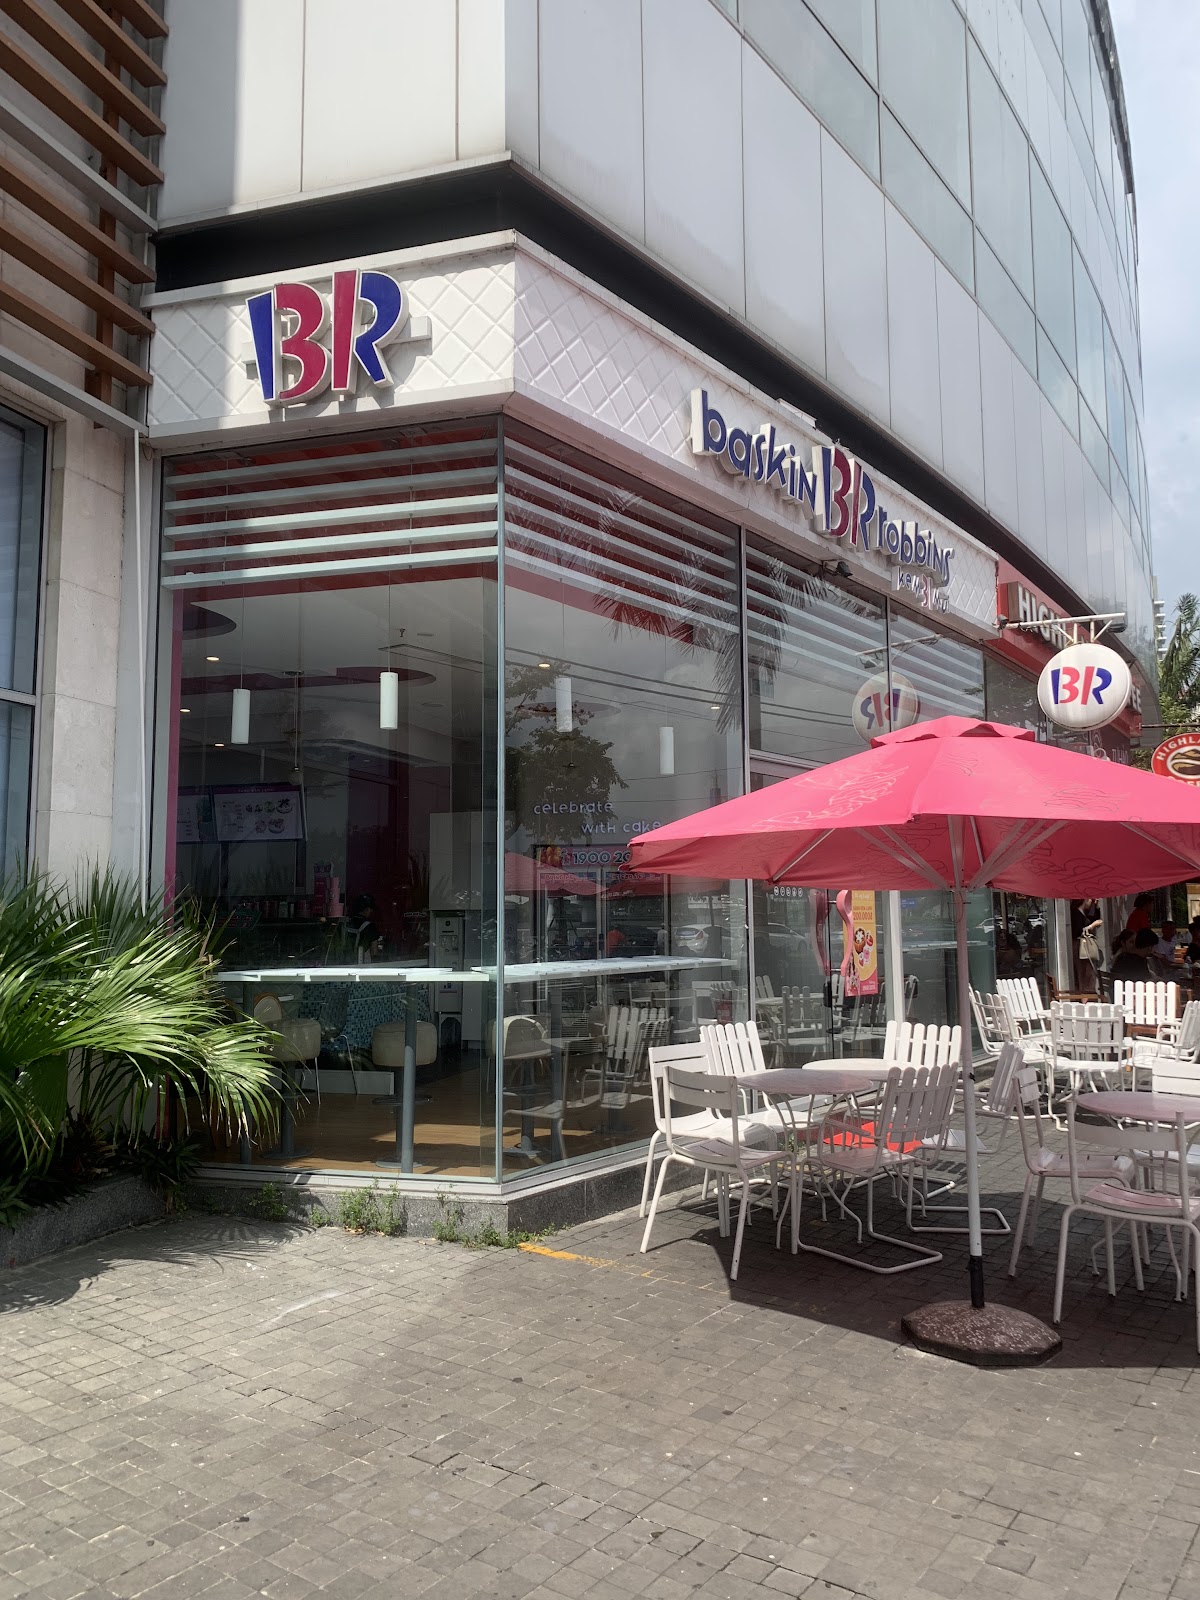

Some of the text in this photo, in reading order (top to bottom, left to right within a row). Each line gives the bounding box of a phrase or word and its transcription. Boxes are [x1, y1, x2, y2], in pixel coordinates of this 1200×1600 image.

[245, 268, 404, 403] BR
[699, 387, 953, 588] baskin BR robbins
[1050, 665, 1113, 706] BR
[533, 801, 613, 815] celebrate
[581, 820, 662, 834] with cake
[572, 850, 612, 865] 1900
